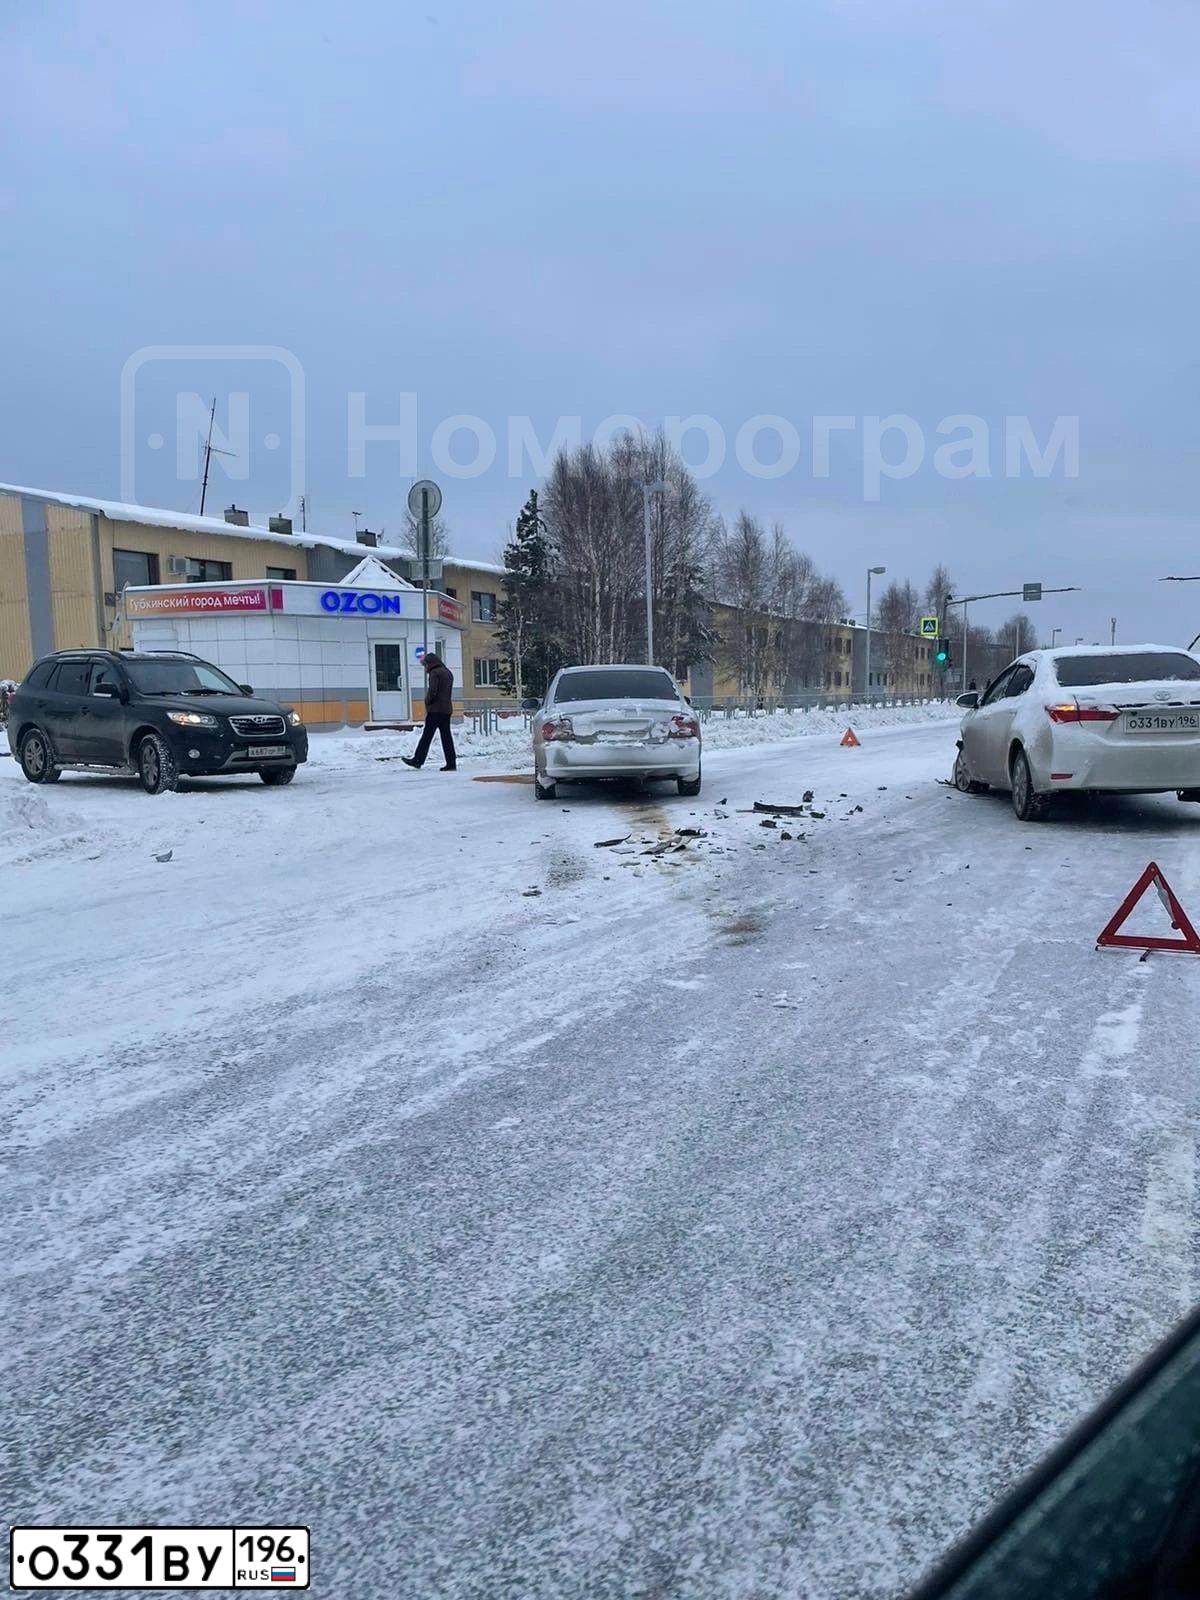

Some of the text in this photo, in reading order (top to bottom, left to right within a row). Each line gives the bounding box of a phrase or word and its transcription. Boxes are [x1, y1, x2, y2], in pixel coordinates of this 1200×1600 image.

[130, 593, 261, 611] Губкинский город мечты!
[320, 591, 401, 614] OZON
[1177, 715, 1196, 725] 196
